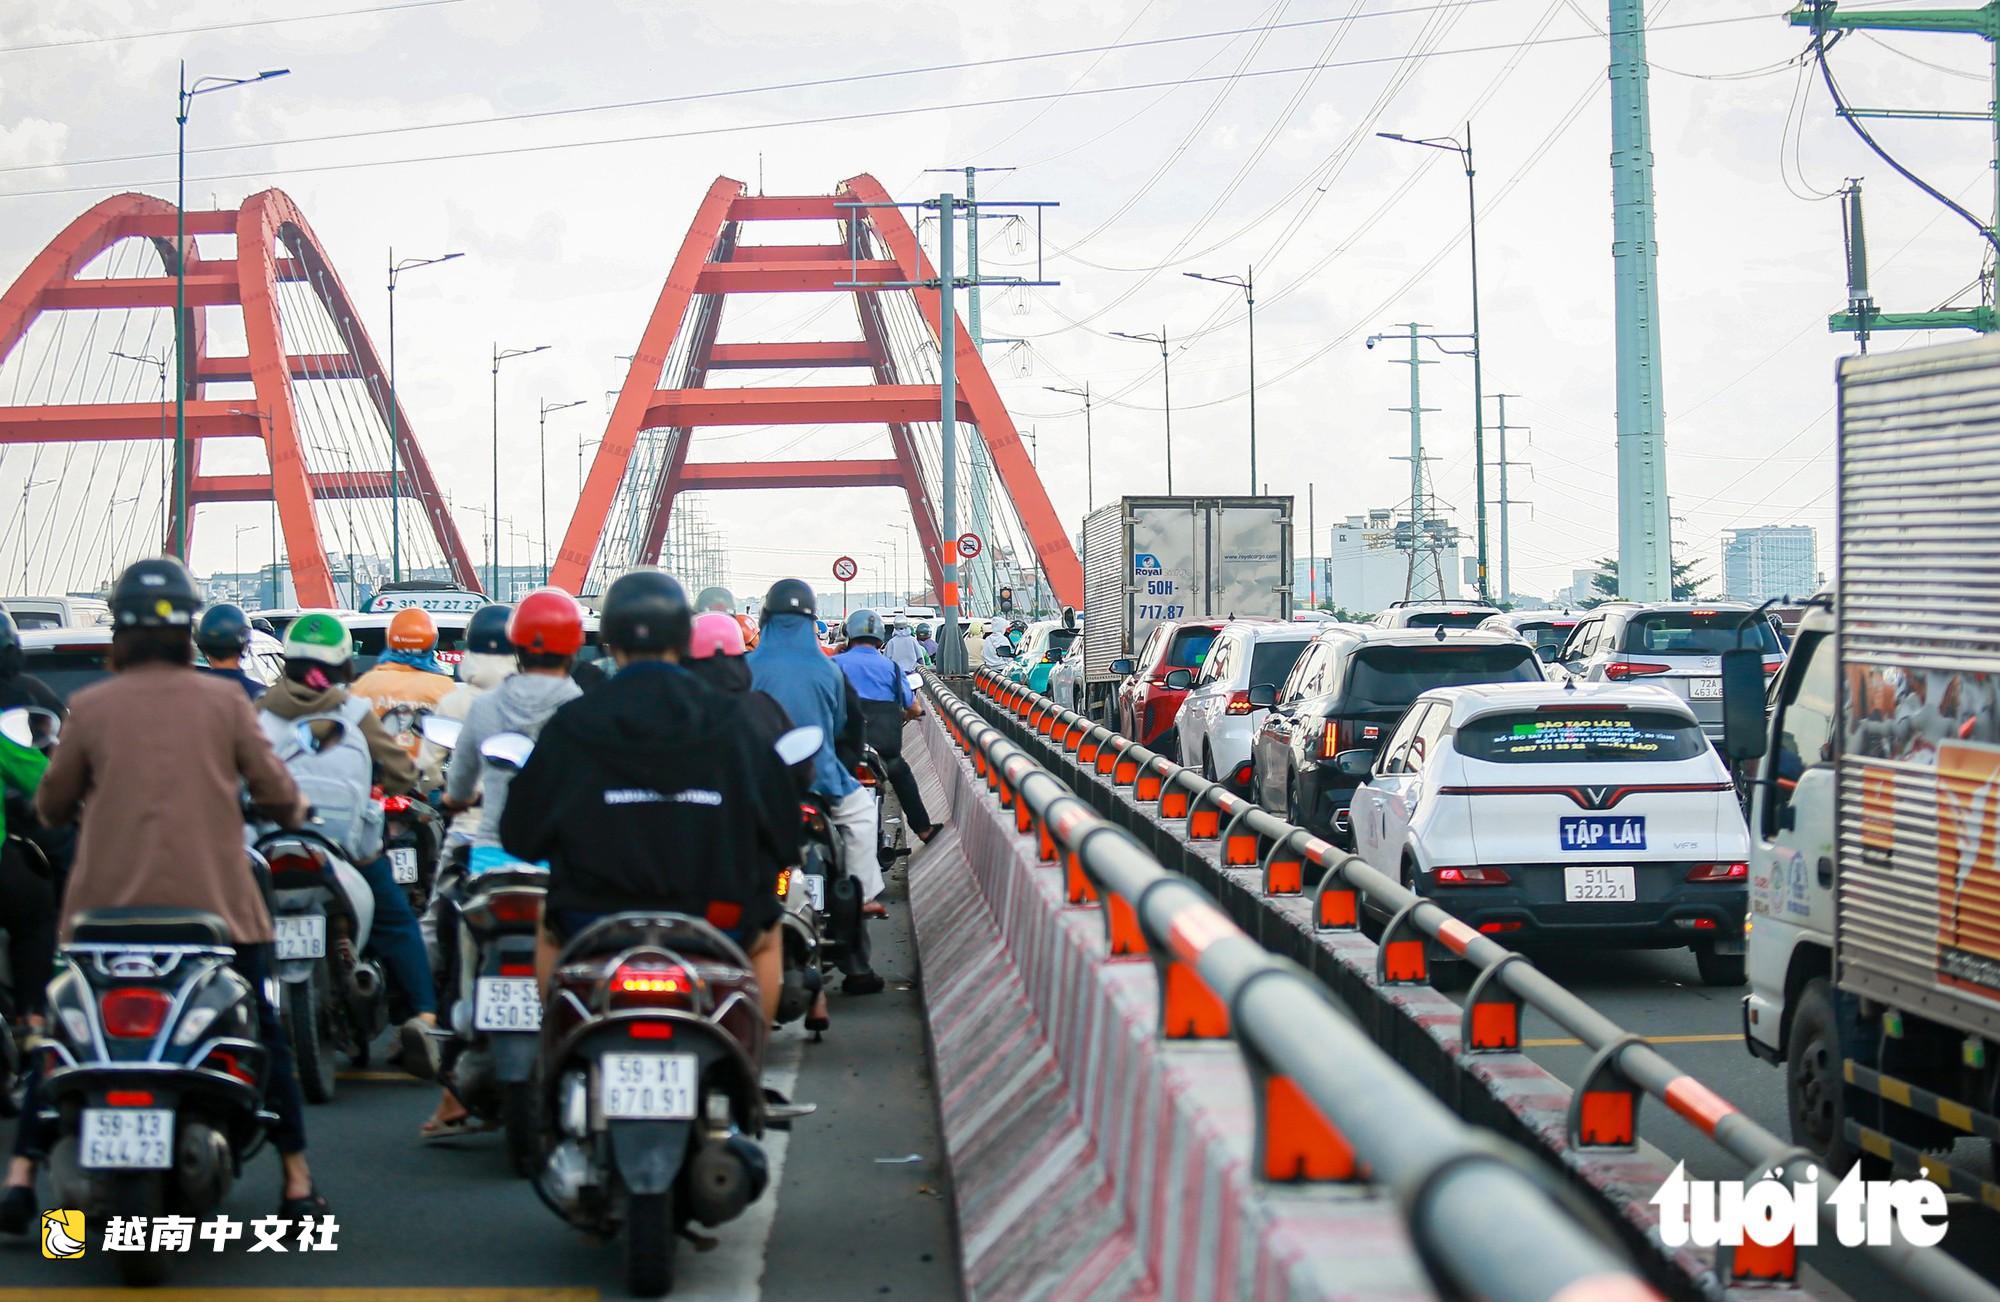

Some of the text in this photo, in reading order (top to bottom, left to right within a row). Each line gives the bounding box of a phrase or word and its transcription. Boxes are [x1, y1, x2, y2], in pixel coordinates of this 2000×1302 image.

[1135, 568, 1162, 576] Royal
[423, 600, 438, 609] 27
[444, 600, 459, 609] 27
[465, 600, 480, 609] 27
[1139, 605, 1184, 620] 717.87
[1700, 679, 1717, 688] 72A
[1564, 818, 1641, 849] TẬP LÁI
[1585, 870, 1614, 883] 51L
[1574, 884, 1626, 899] 322.21
[617, 1055, 681, 1084] 59-X1
[97, 1114, 161, 1137] 59-X3
